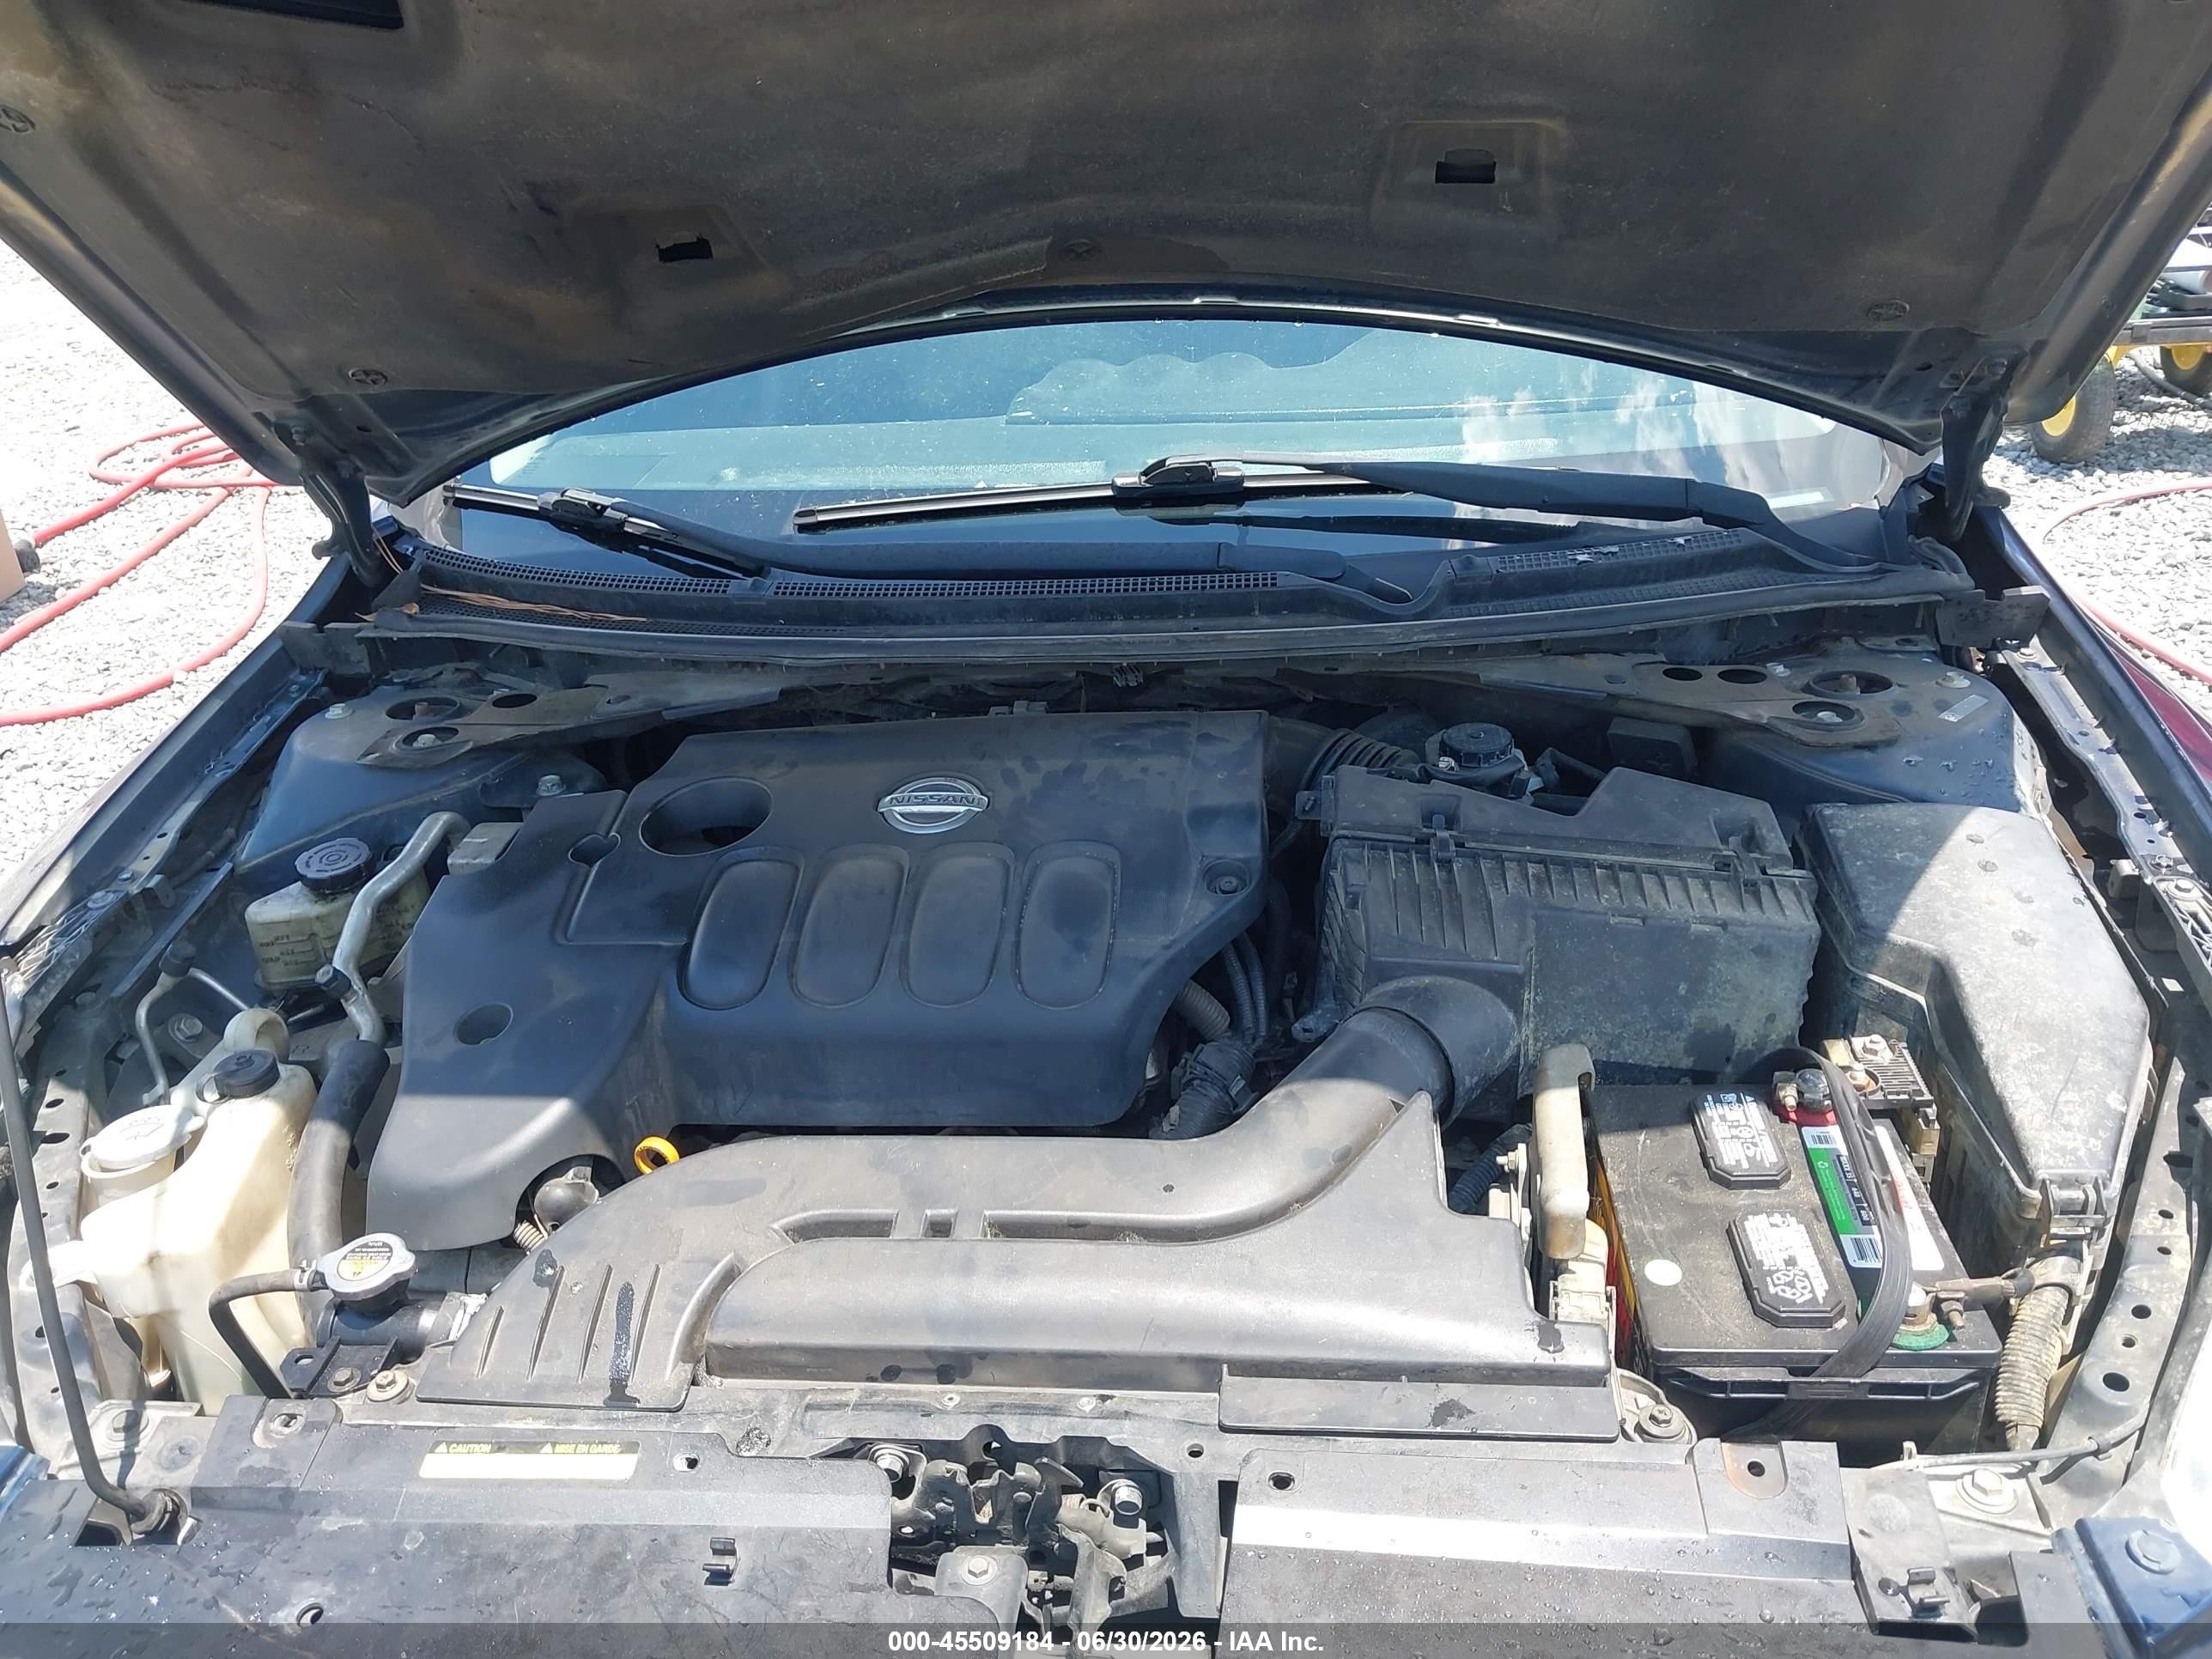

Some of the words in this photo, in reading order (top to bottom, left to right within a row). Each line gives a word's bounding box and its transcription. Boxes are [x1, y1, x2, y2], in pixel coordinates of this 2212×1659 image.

[890, 794, 976, 805] NISSAN
[449, 1443, 492, 1454] CAUTION
[575, 1443, 590, 1454] EN
[589, 1443, 622, 1454] GARDE
